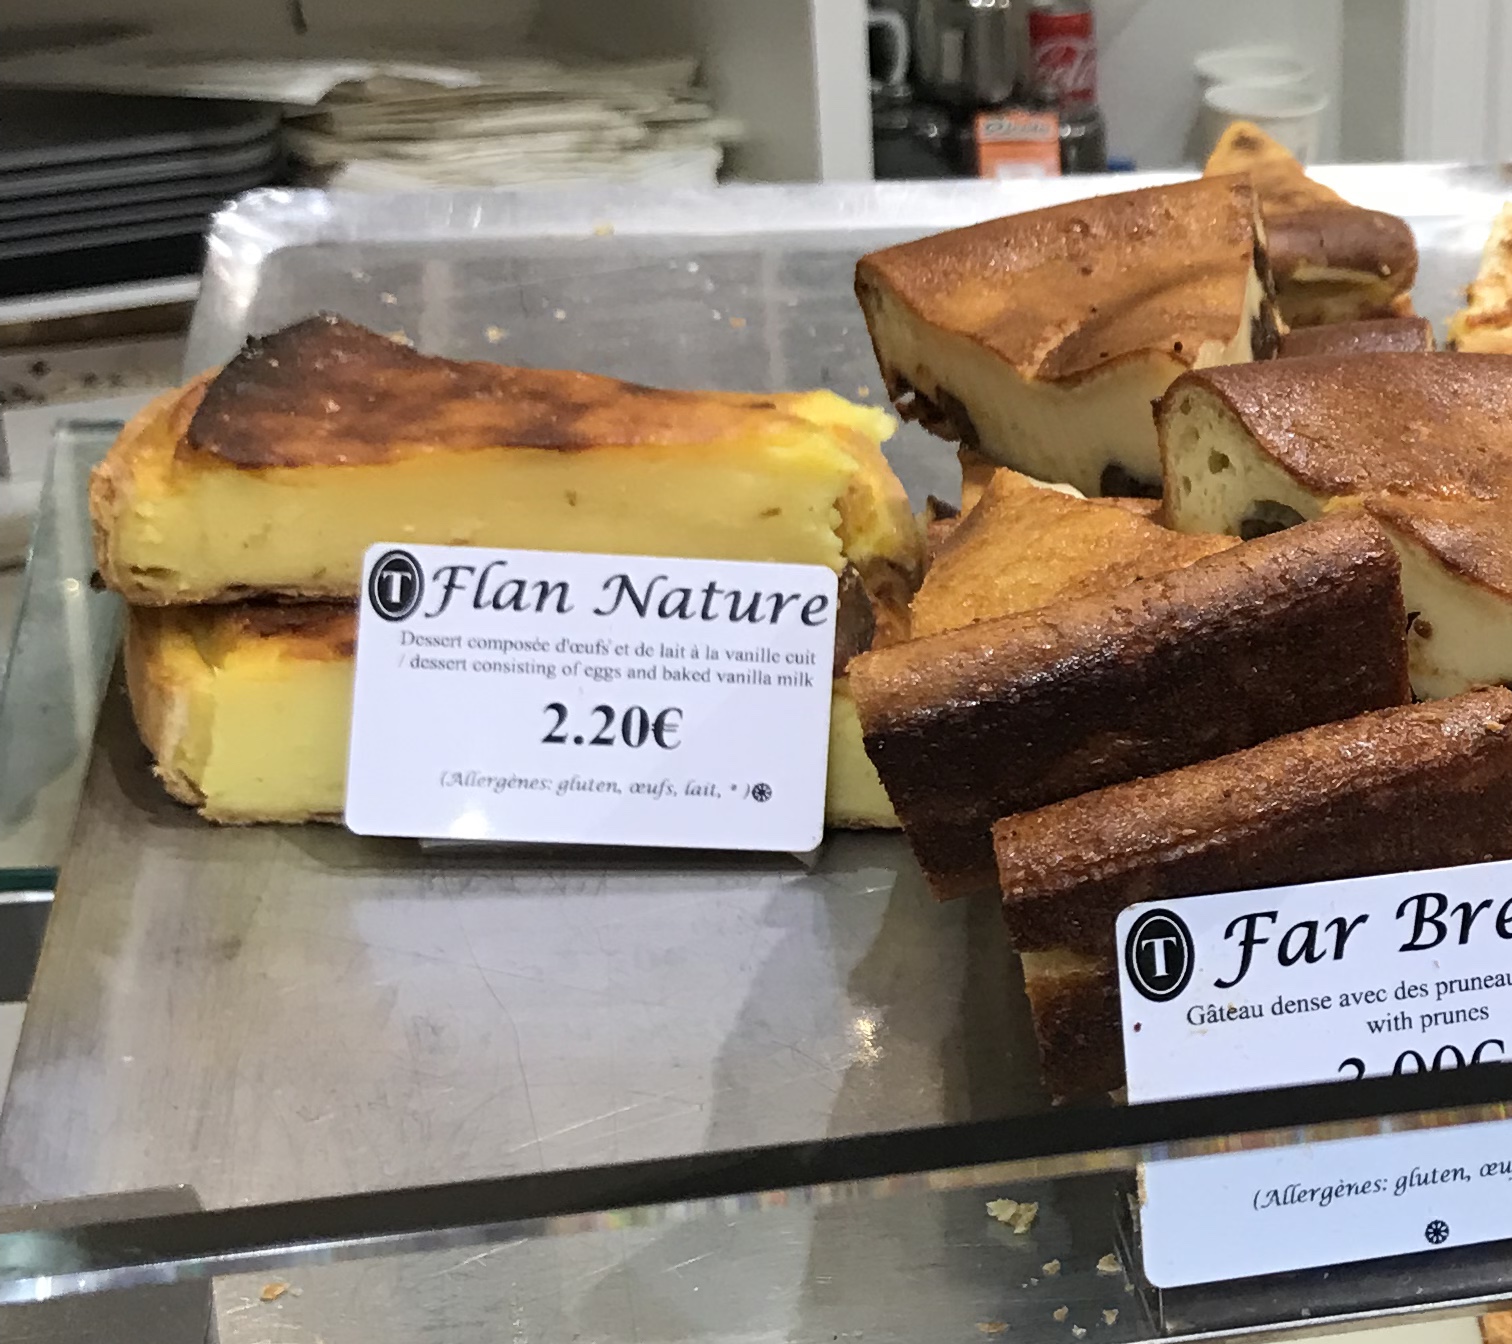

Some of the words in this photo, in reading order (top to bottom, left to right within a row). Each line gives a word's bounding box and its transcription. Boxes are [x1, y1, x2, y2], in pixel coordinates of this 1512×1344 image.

[425, 561, 574, 618] Flan
[593, 574, 829, 627] Nature
[400, 630, 462, 649] Dessert
[467, 635, 551, 654] composée
[615, 643, 630, 657] et
[635, 641, 656, 657] de
[660, 642, 686, 659] lait
[690, 644, 700, 660] à
[706, 645, 720, 661] la
[724, 647, 782, 665] vanille
[784, 649, 816, 666] cuit
[410, 654, 467, 672] dessert
[472, 659, 557, 680] consisting
[562, 661, 583, 677] of
[583, 667, 622, 682] eggs
[627, 665, 658, 681] and
[662, 666, 711, 683] baked
[716, 670, 773, 687] vanilla
[777, 671, 815, 689] milk
[541, 702, 684, 750] 2.20€
[555, 774, 623, 798] gluten,
[629, 778, 679, 800] œufs,
[684, 780, 722, 800] lait,
[1215, 910, 1369, 990] Far
[1186, 997, 1265, 1027] Gâteau
[1272, 989, 1333, 1017] dense
[1339, 987, 1388, 1008] avec
[1394, 975, 1431, 1002] des
[1367, 1009, 1414, 1035] with
[1419, 1003, 1490, 1036] prunes
[1252, 1173, 1390, 1212] (Allergènes:
[1394, 1162, 1472, 1197] gluten,
